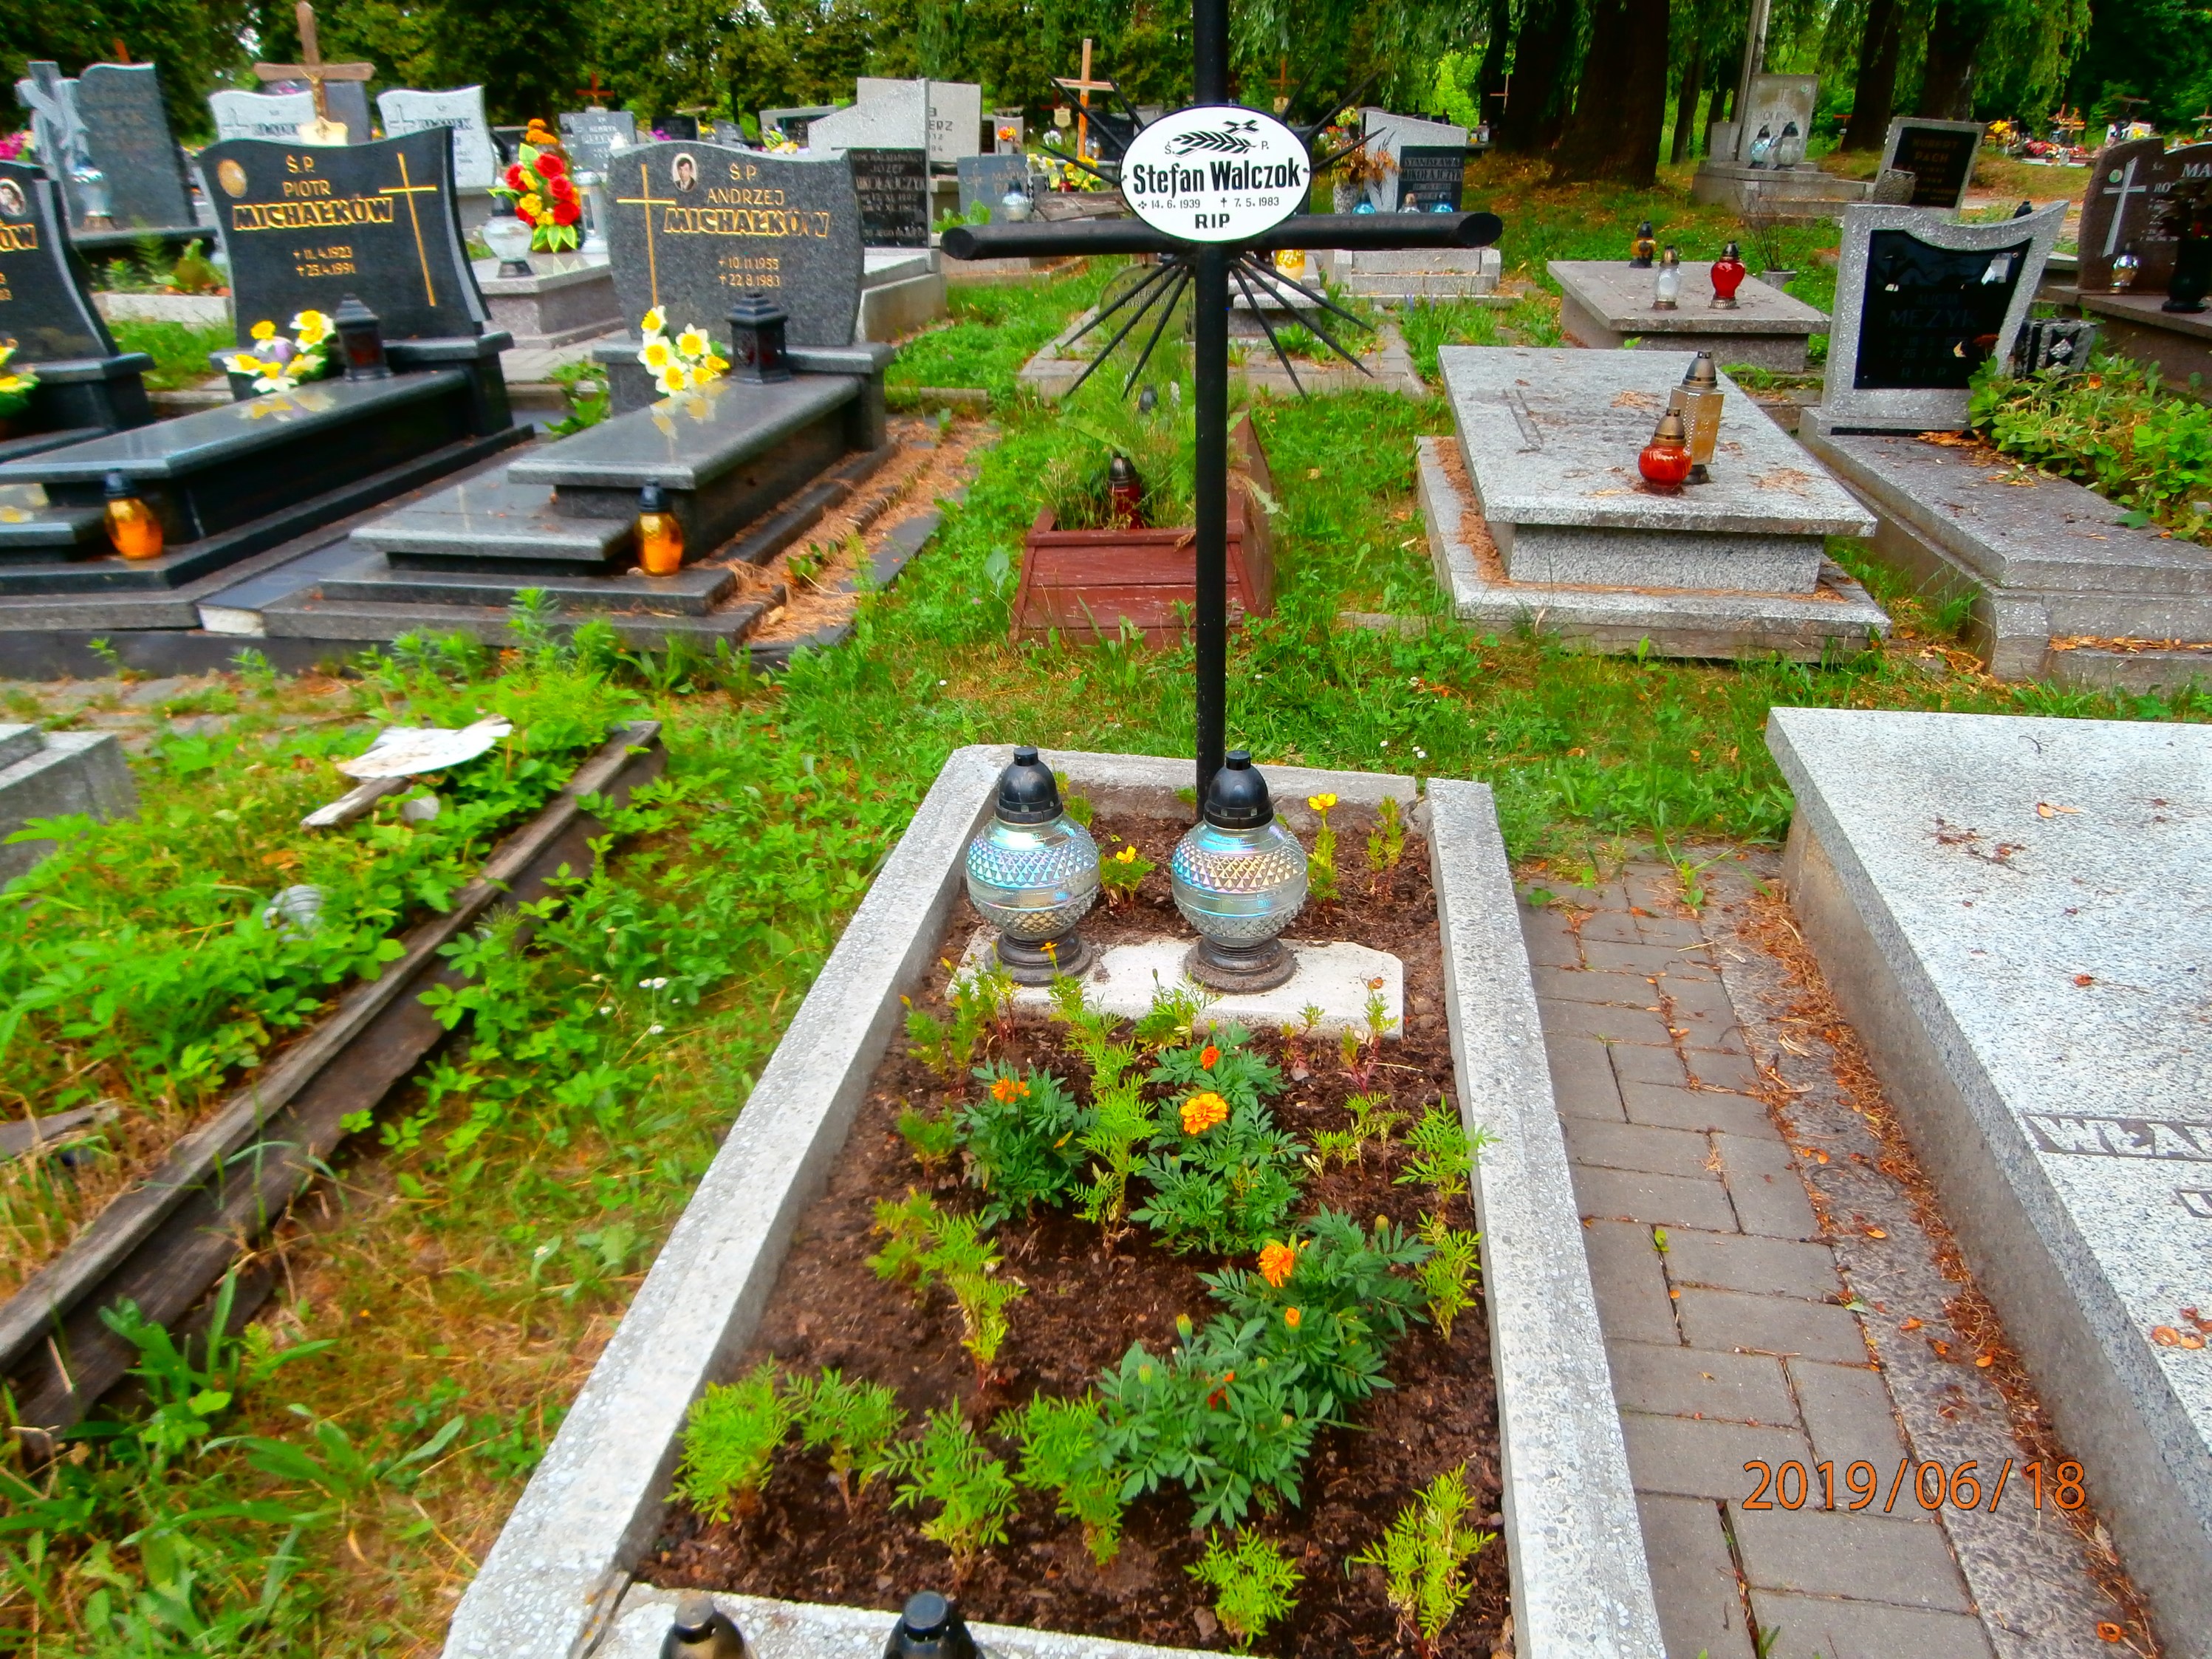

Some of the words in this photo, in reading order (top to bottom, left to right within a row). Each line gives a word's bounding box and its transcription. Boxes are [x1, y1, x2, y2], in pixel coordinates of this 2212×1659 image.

[929, 120, 953, 131] ERZ
[1133, 162, 1205, 199] Stefan
[1210, 157, 1301, 191] Walczok
[282, 179, 332, 198] PIOTR
[707, 188, 785, 206] ANDRZEJ
